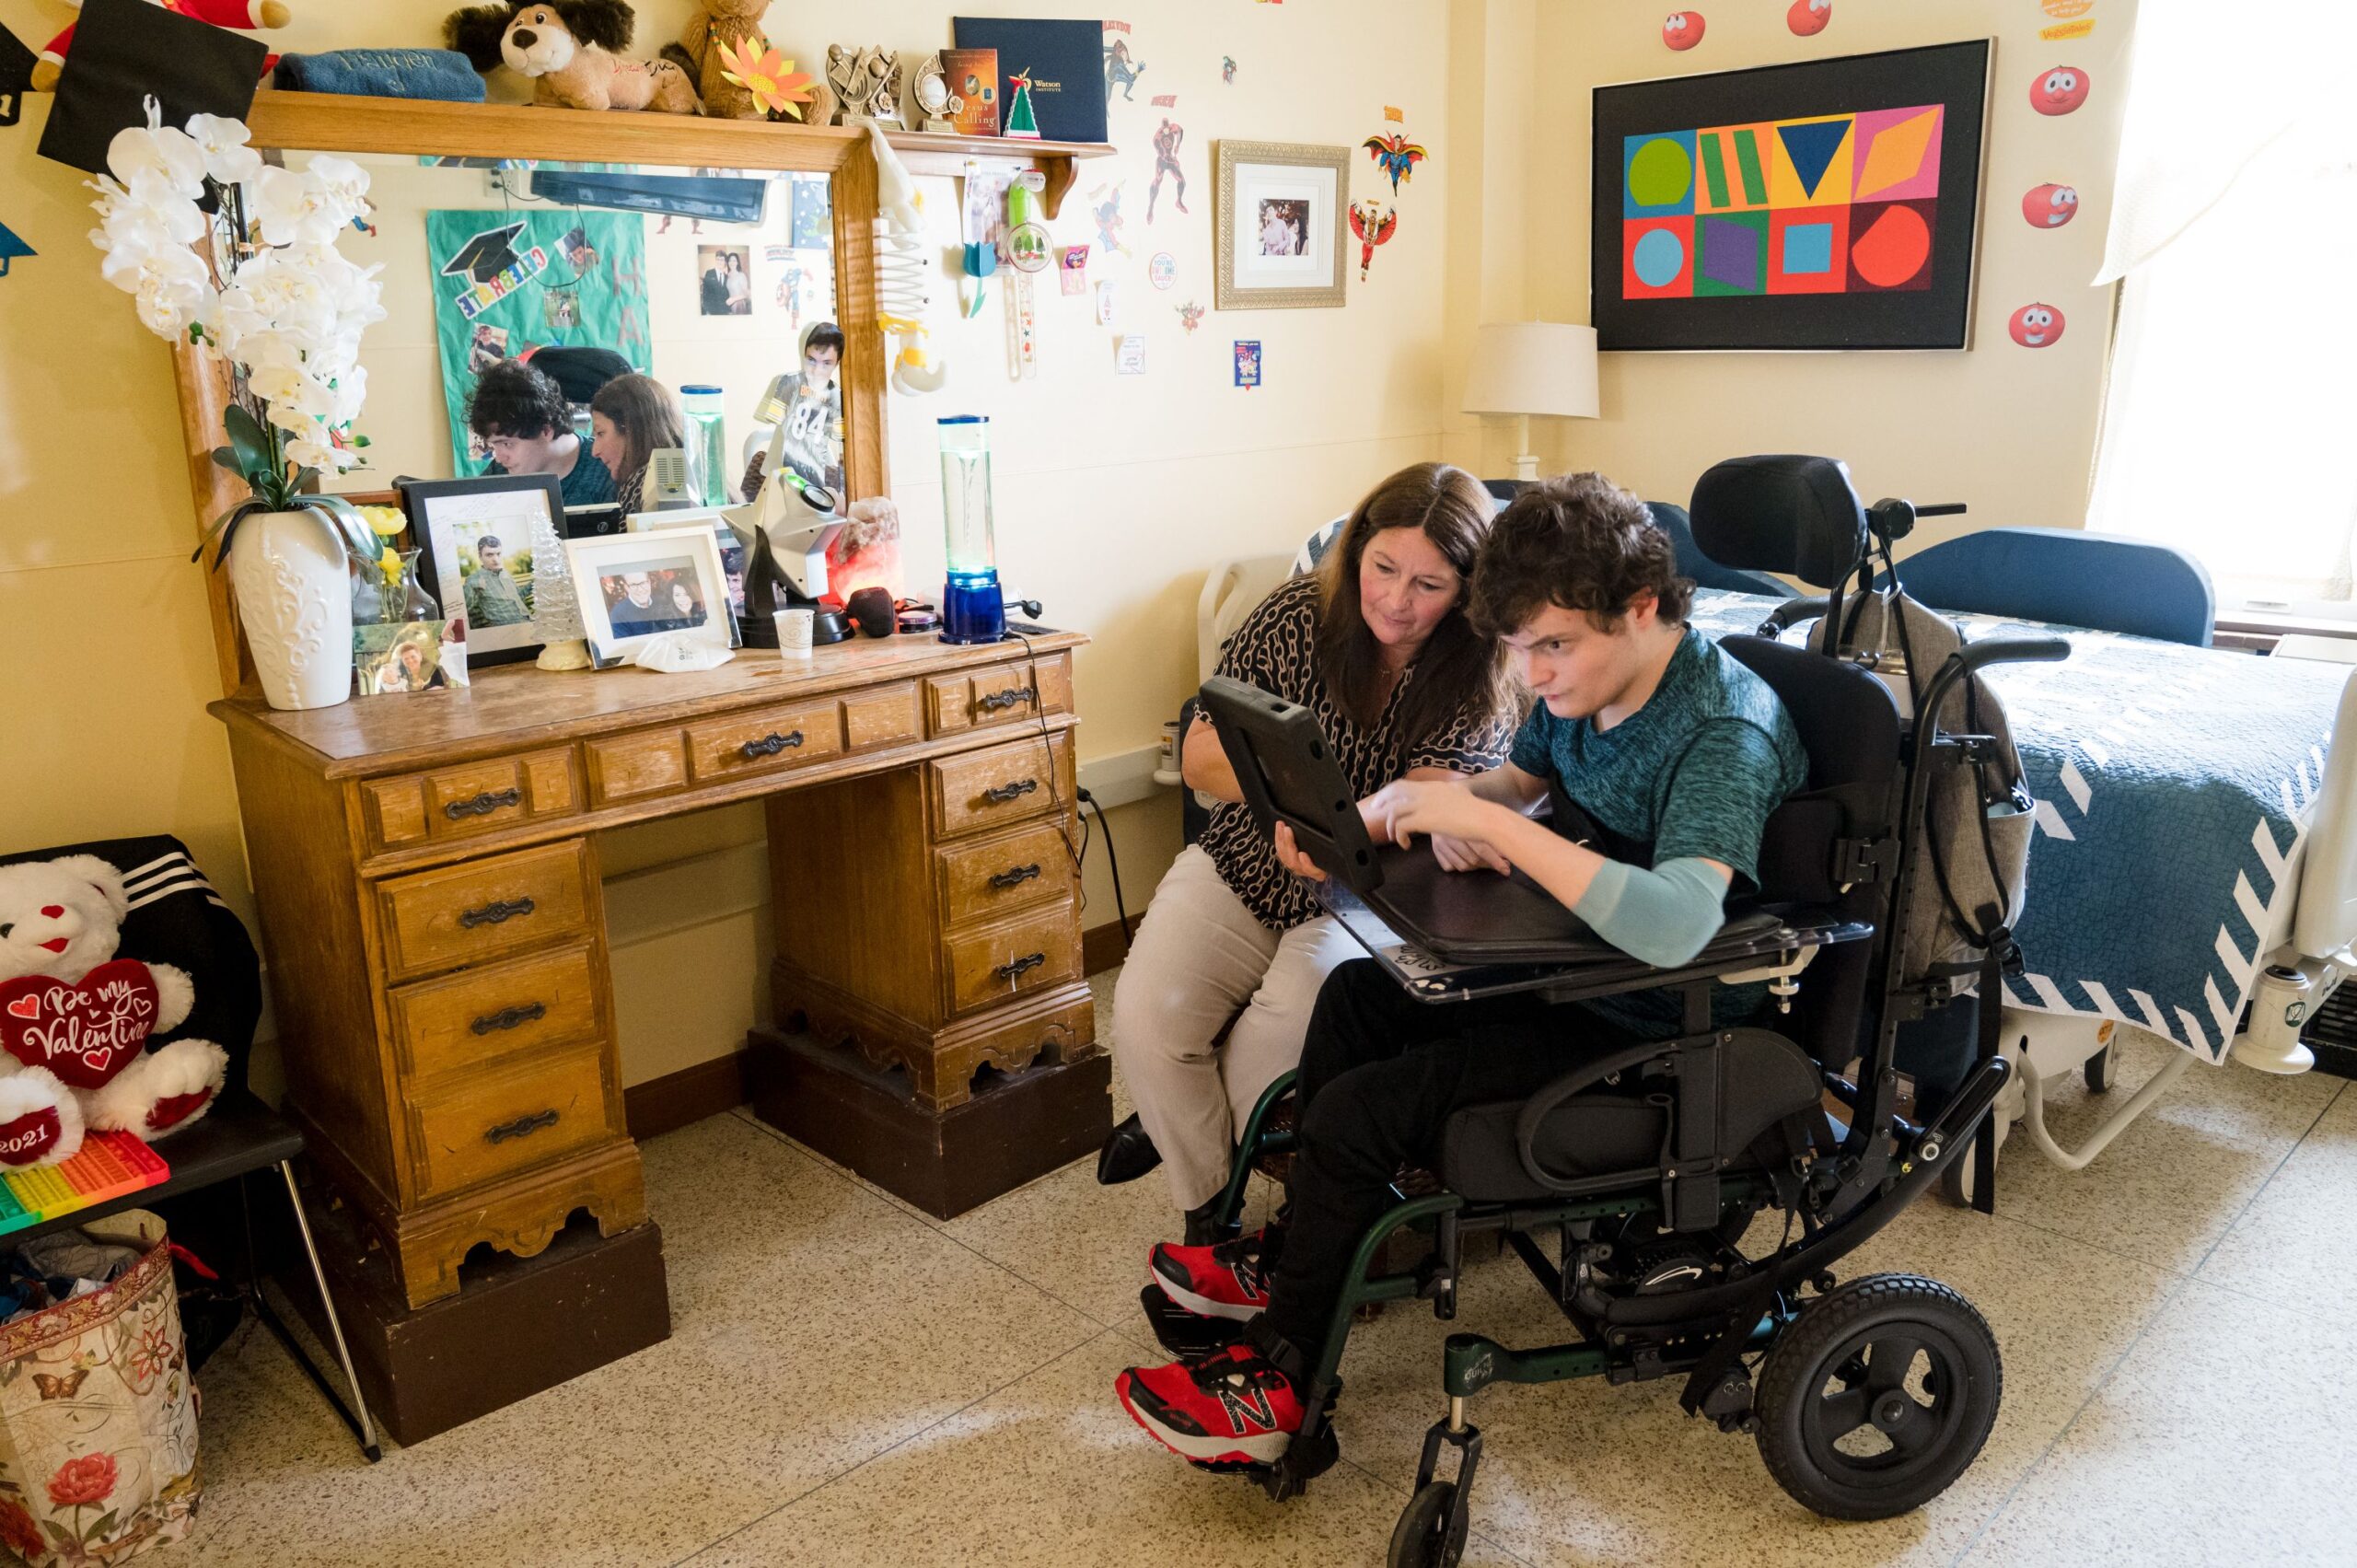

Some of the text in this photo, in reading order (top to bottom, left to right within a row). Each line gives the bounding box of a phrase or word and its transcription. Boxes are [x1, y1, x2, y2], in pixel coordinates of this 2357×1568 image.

[954, 112, 996, 127] Calling
[792, 402, 829, 444] 84
[44, 980, 147, 1016] Be my
[23, 1011, 149, 1060] Valentine
[0, 1123, 49, 1153] 2021
